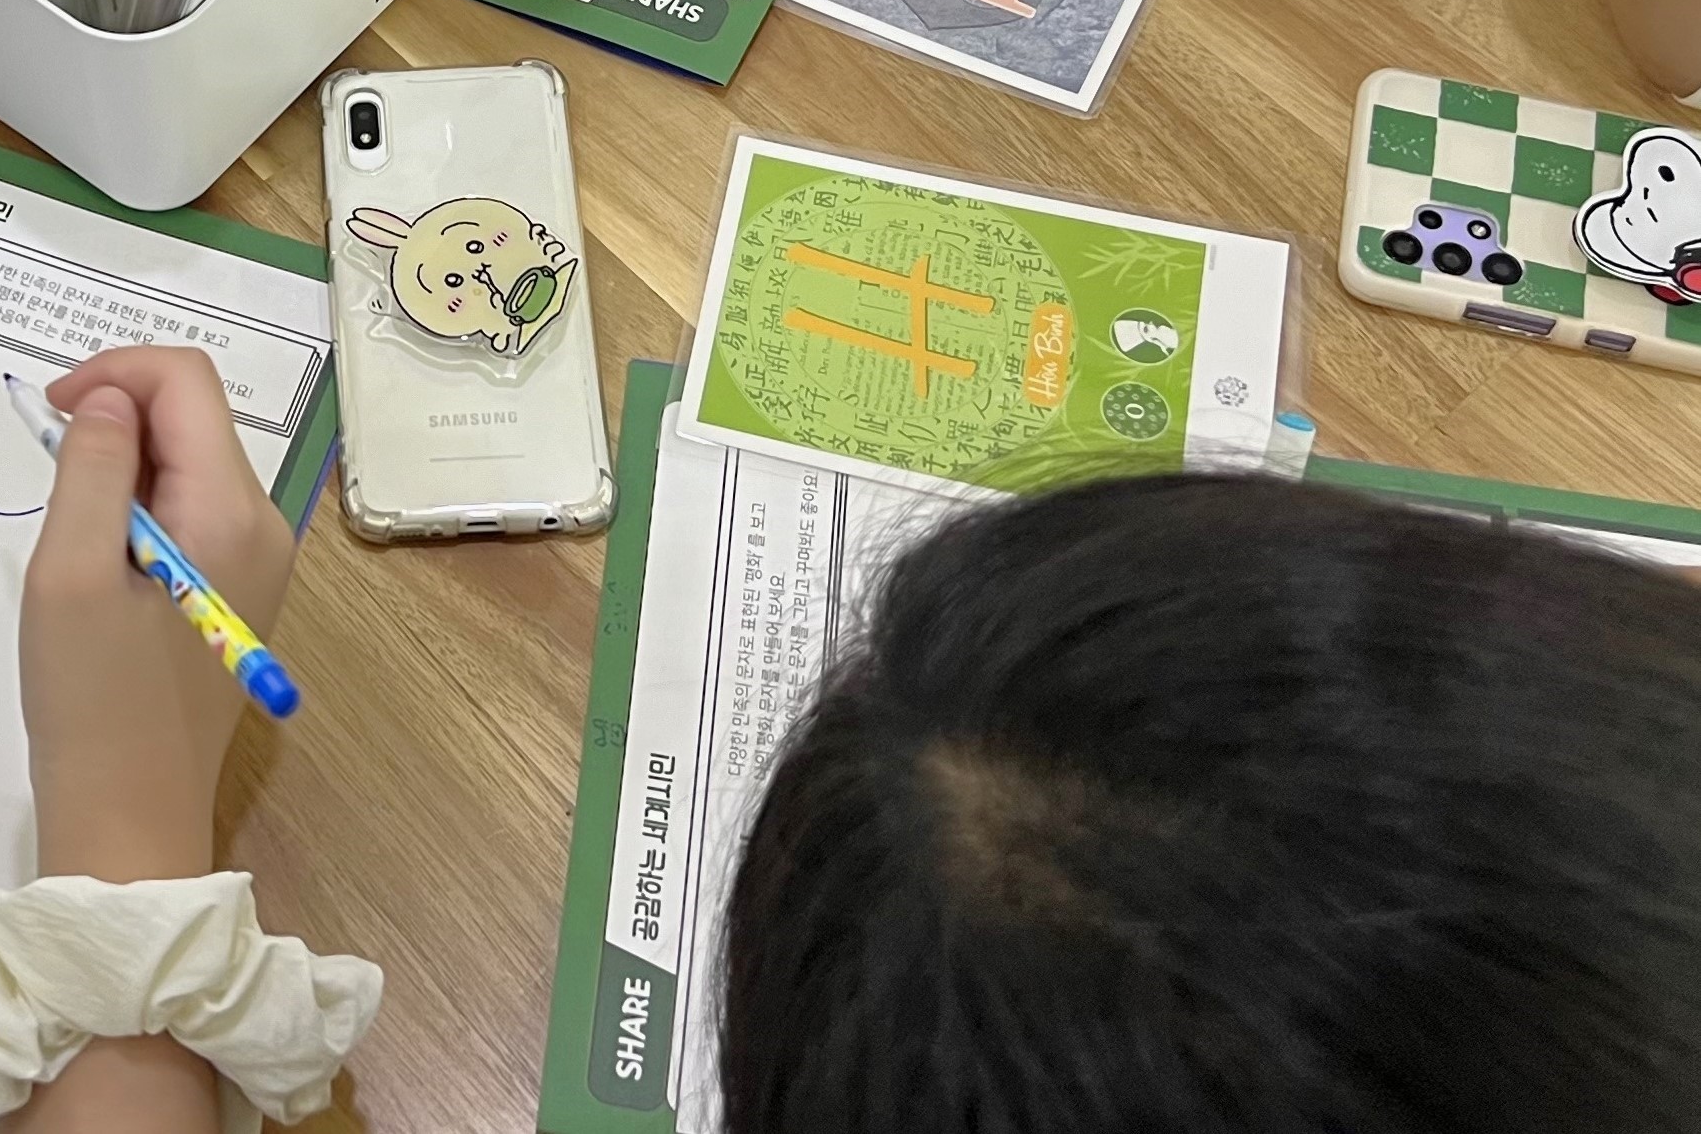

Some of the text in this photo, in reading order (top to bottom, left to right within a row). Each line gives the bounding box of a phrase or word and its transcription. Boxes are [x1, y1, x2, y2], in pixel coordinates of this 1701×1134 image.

[20, 272, 61, 296] 민족의
[63, 287, 103, 309] 문자로
[105, 301, 147, 324] 표현된
[186, 326, 199, 340] 를
[201, 331, 229, 349] 보고
[27, 296, 68, 319] 문자를
[71, 310, 112, 334] 만들어
[30, 319, 58, 338] 드는
[58, 326, 103, 355] 문자를
[427, 409, 520, 430] SAMSUNG
[747, 500, 770, 531] 보고
[792, 516, 818, 575] 꾸며봐도
[738, 587, 762, 633] 표현된
[764, 572, 788, 619] 보세요
[788, 575, 813, 621] 그리고
[734, 632, 759, 680] 문자로
[760, 620, 784, 666] 만들어
[784, 622, 809, 669] 문자를
[730, 679, 754, 728] 민족의
[756, 667, 780, 714] 문자를
[725, 727, 750, 778] 다양한
[632, 753, 675, 940] 공감하는 세계시민
[615, 976, 652, 1082] SHARE
